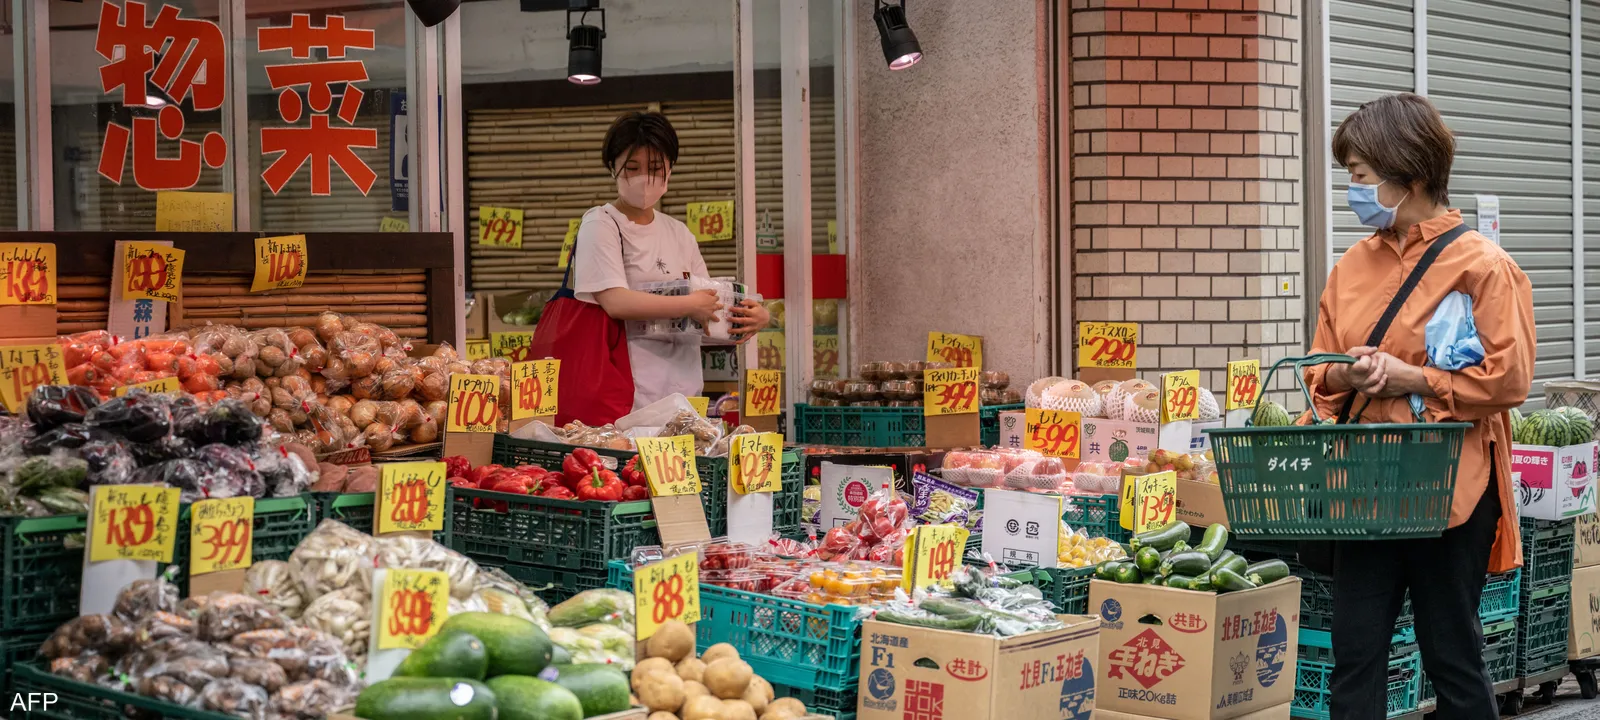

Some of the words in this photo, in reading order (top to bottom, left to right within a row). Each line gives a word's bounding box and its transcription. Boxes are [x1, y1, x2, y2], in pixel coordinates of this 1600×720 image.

[95, 0, 378, 197] 惣菜
[483, 218, 516, 243] 199
[267, 252, 302, 283] 160
[1088, 336, 1136, 363] 790
[935, 381, 977, 410] 399
[1171, 375, 1191, 388] プラム
[455, 391, 499, 427] 100
[751, 385, 779, 412] 499
[1168, 386, 1198, 417] 399
[1040, 411, 1063, 424] もも
[741, 436, 762, 452] トマト
[1031, 423, 1079, 453] 599
[654, 450, 686, 484] 160
[1267, 456, 1312, 471] ダイイチ
[1141, 494, 1174, 527] 139
[200, 519, 250, 566] 399
[928, 540, 955, 580] 199
[653, 573, 685, 624] 88
[1174, 612, 1202, 629] 共計
[1221, 607, 1277, 641] 北見F1玉ねぎ
[870, 633, 909, 648] 北海道産
[1136, 637, 1160, 649] 北見
[871, 646, 895, 668] F1
[952, 658, 981, 676] 共計
[1020, 649, 1084, 690] 北見F1玉ねぎ
